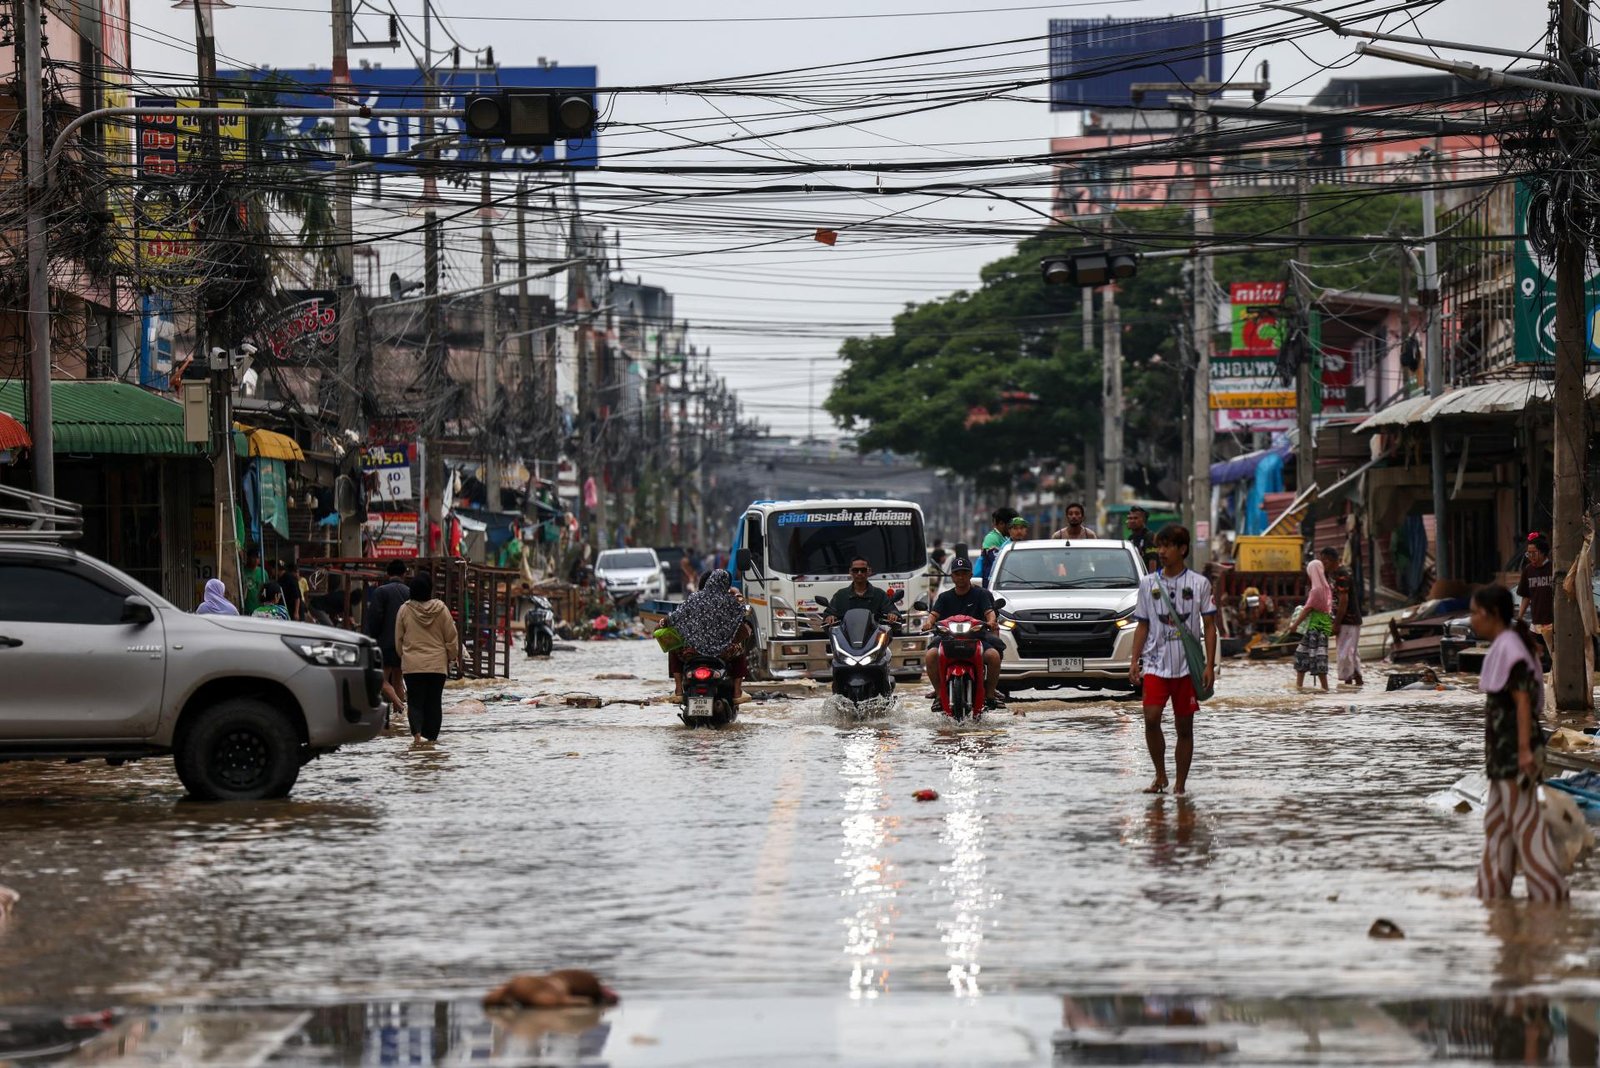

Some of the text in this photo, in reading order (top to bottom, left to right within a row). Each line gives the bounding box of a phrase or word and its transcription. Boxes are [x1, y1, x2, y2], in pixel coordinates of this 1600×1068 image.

[1236, 284, 1282, 301] mini
[853, 512, 863, 521] &
[1049, 612, 1081, 620] ISUZU
